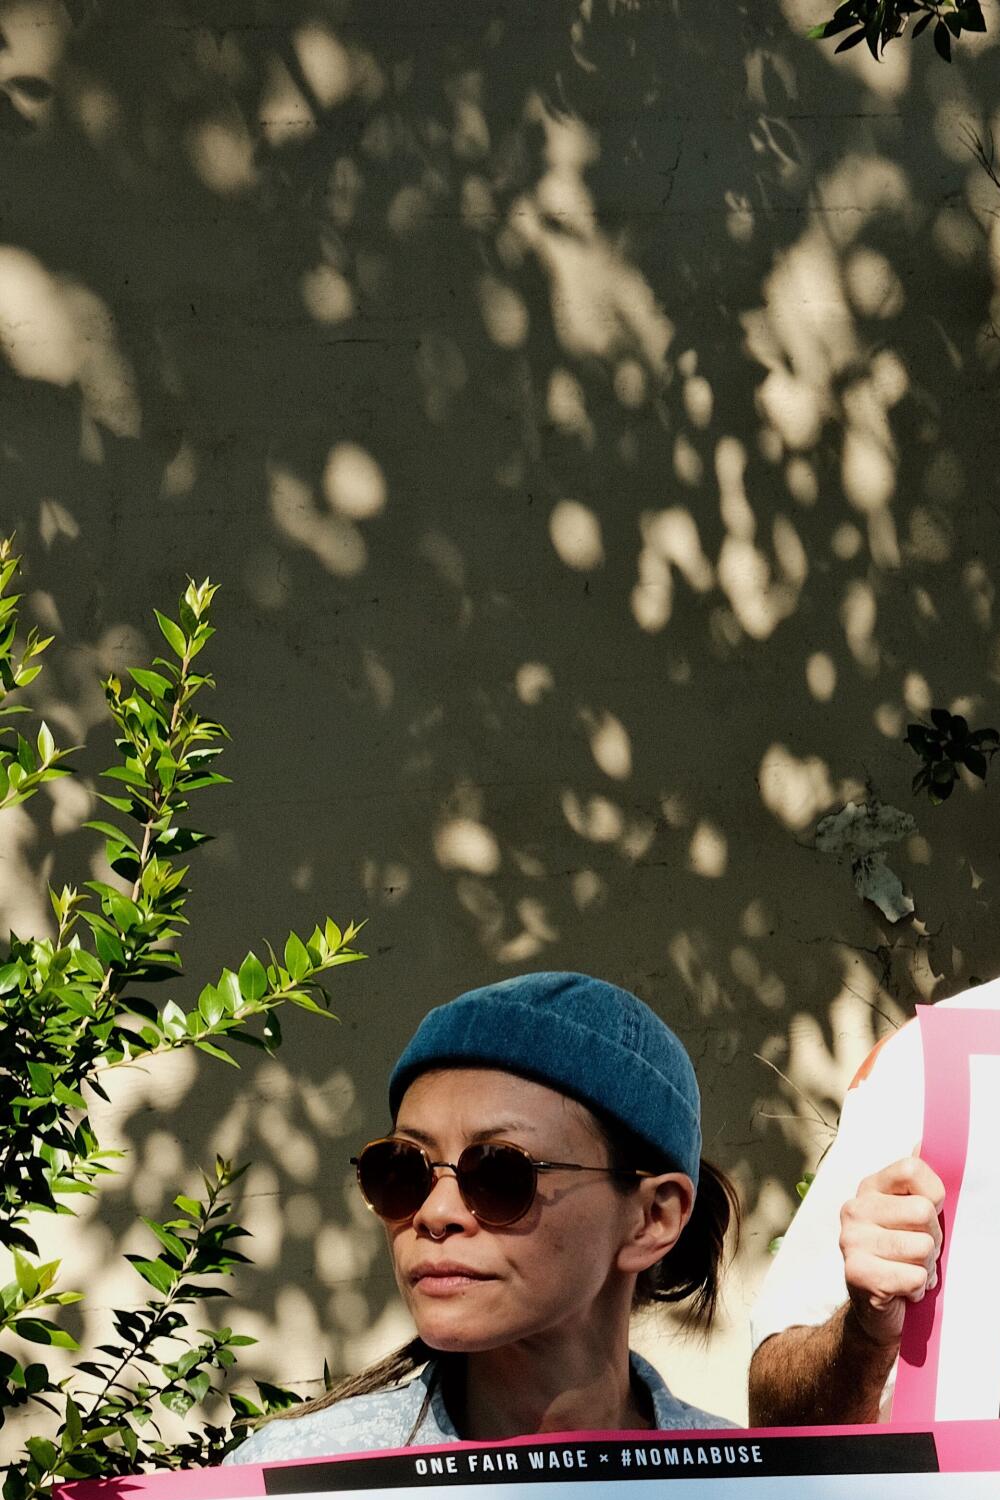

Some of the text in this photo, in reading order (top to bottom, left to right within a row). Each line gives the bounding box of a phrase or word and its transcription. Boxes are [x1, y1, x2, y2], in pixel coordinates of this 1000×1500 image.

[415, 1457, 458, 1475] ONE
[469, 1453, 519, 1472] FAIR
[528, 1450, 589, 1470] WAGE
[622, 1445, 763, 1467] #NOMAABUSE
